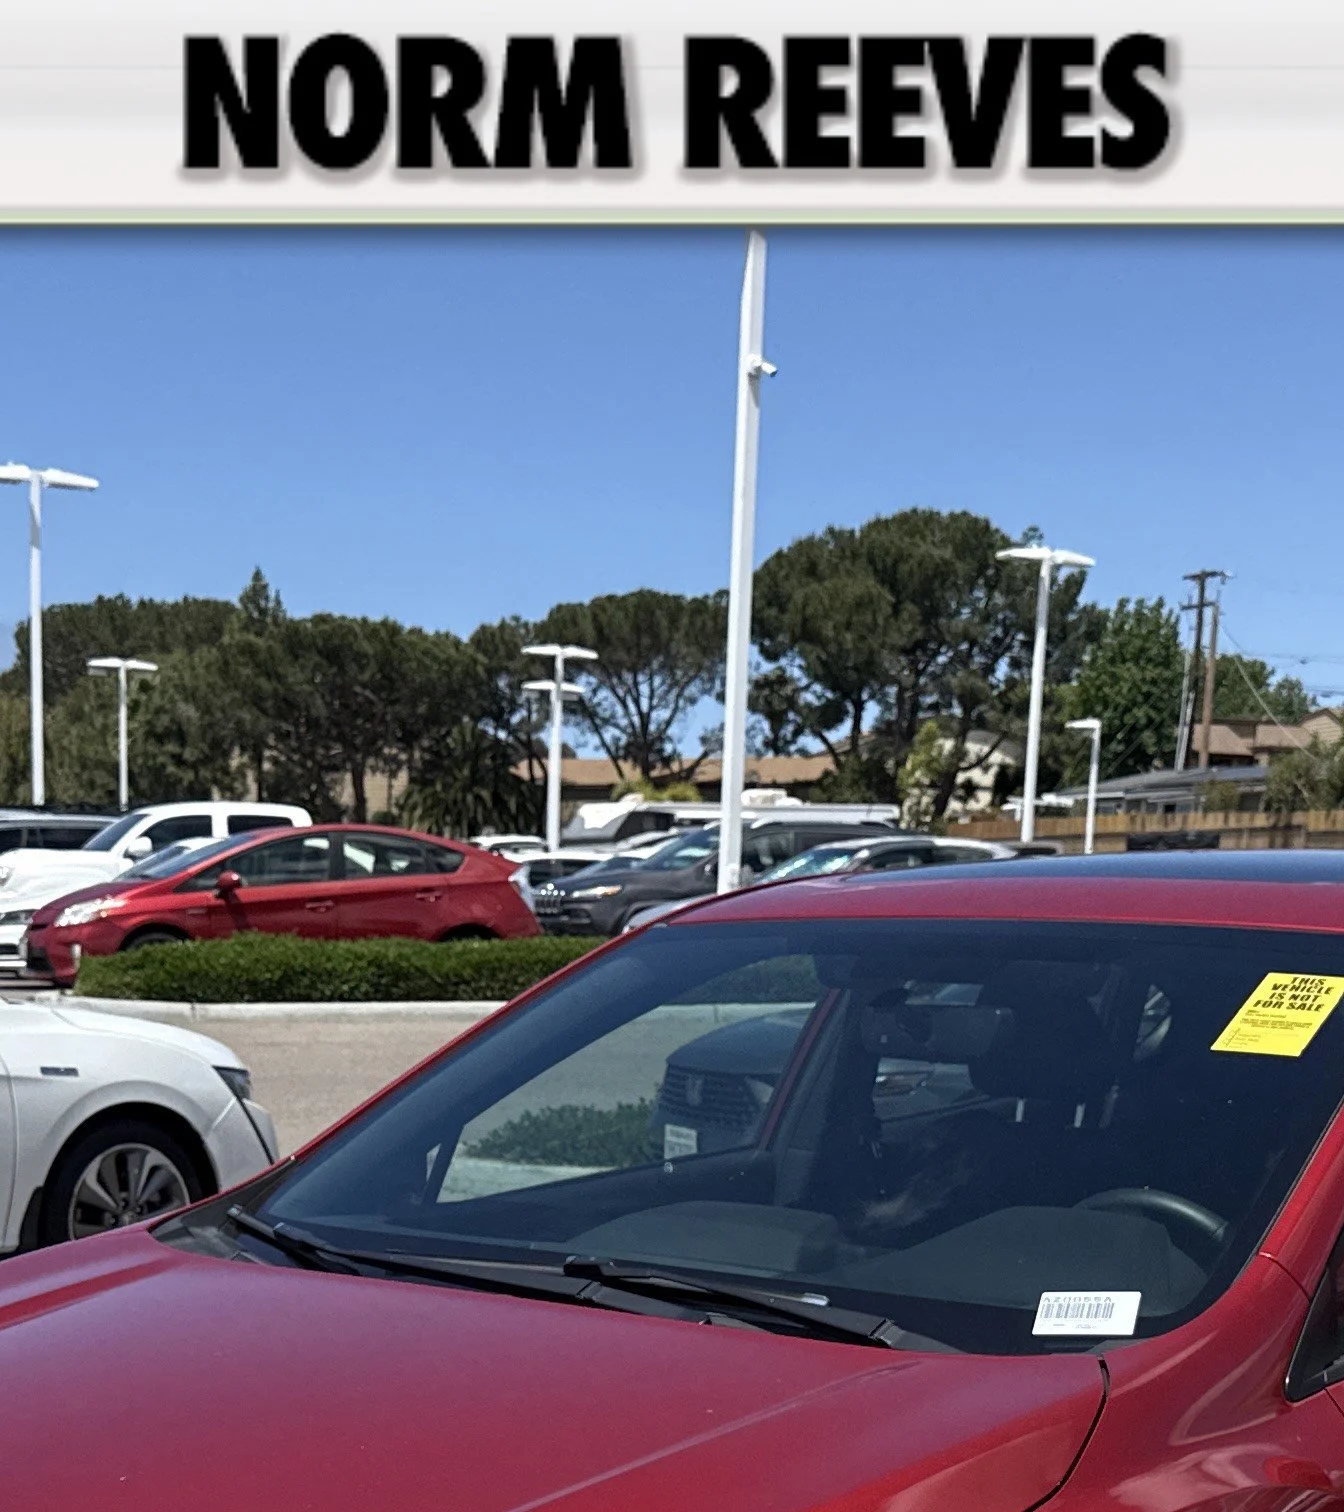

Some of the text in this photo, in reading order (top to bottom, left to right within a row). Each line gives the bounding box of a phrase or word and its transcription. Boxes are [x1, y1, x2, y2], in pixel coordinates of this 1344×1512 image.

[1290, 976, 1327, 986] THIS
[1271, 983, 1334, 995] VEHICLE
[1269, 992, 1321, 1003] IS NOT
[1253, 1000, 1325, 1012] FOR SALE
